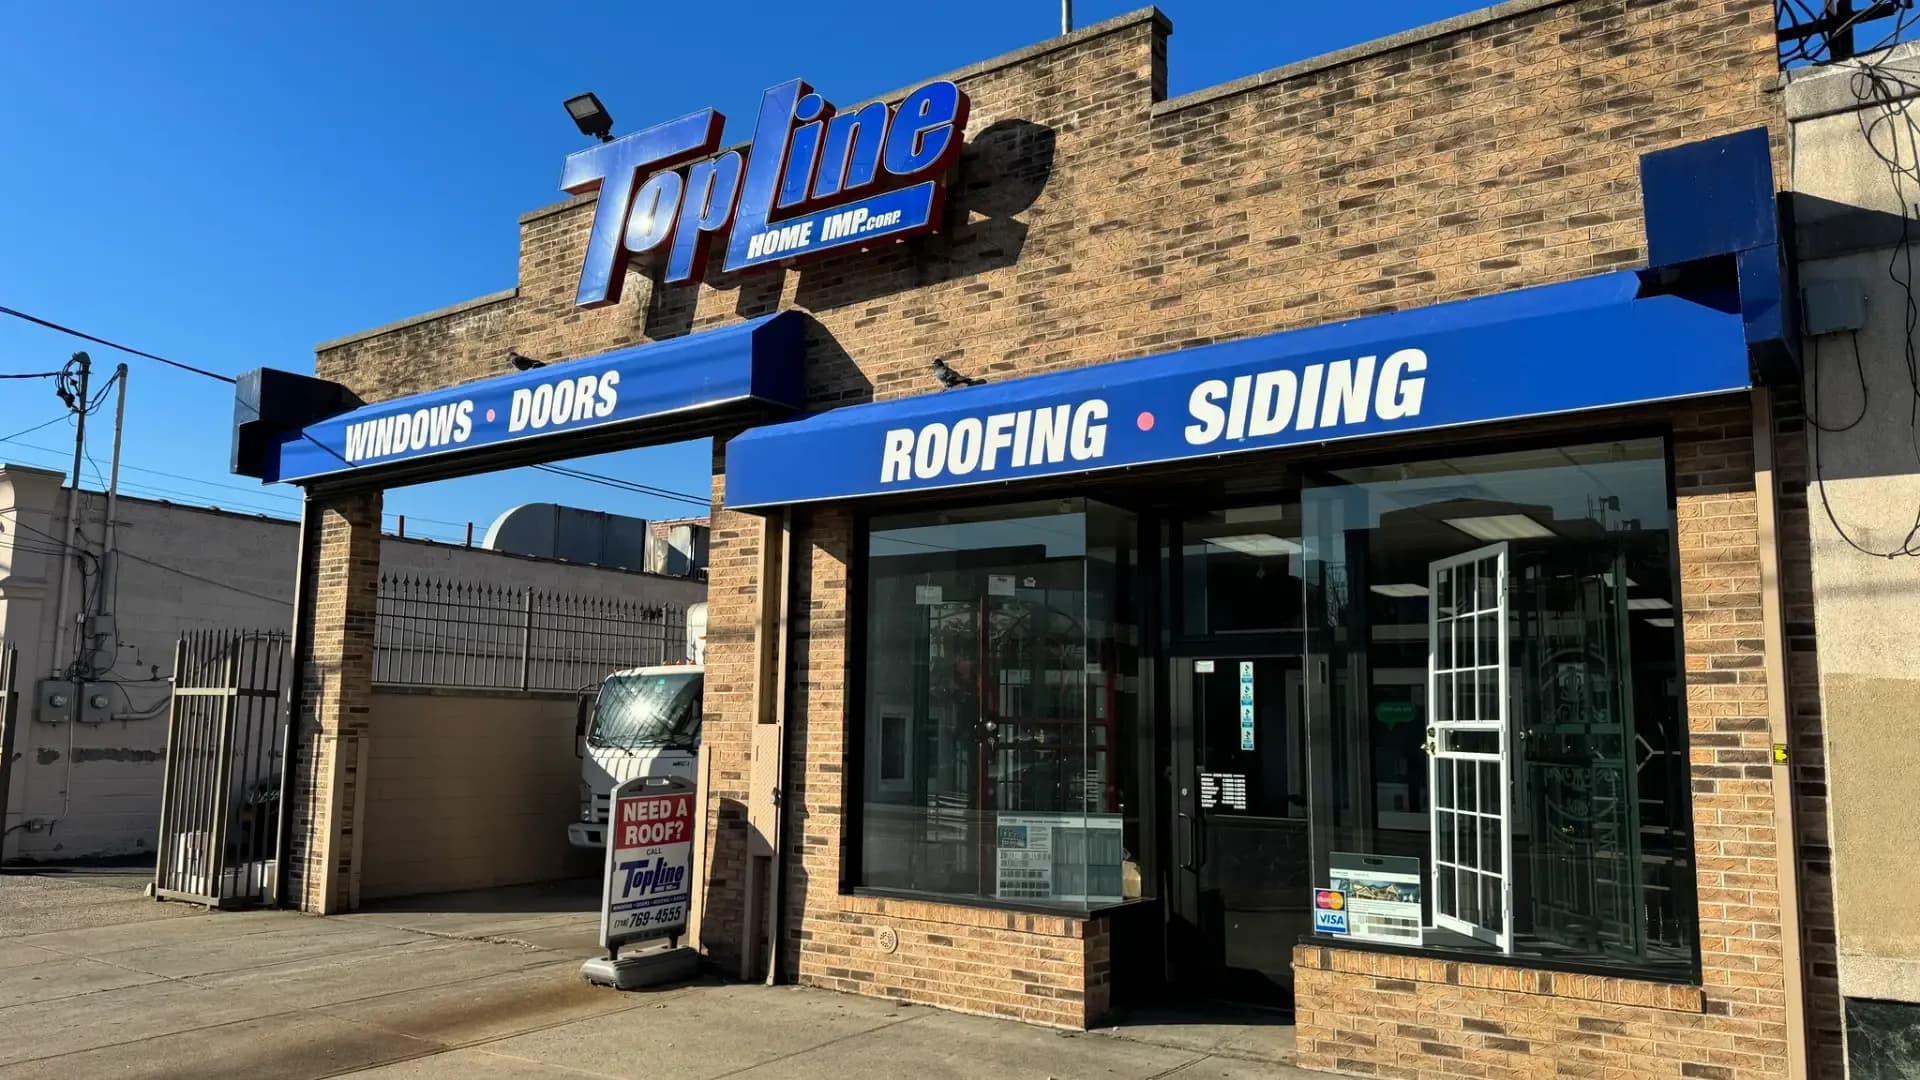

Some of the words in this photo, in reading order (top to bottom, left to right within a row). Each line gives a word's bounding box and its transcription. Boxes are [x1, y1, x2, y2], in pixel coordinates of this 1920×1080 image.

[746, 221, 813, 259] HOME
[345, 400, 474, 462] WINDOWS
[508, 370, 620, 432] DOORS
[880, 399, 1108, 484] ROOFING
[1184, 348, 1428, 446] SIDING
[623, 799, 672, 822] NEED
[676, 798, 688, 817] A
[624, 822, 685, 845] ROOF?
[646, 848, 662, 856] CALL
[628, 905, 682, 928] 769-4555
[1320, 914, 1344, 925] VISA
